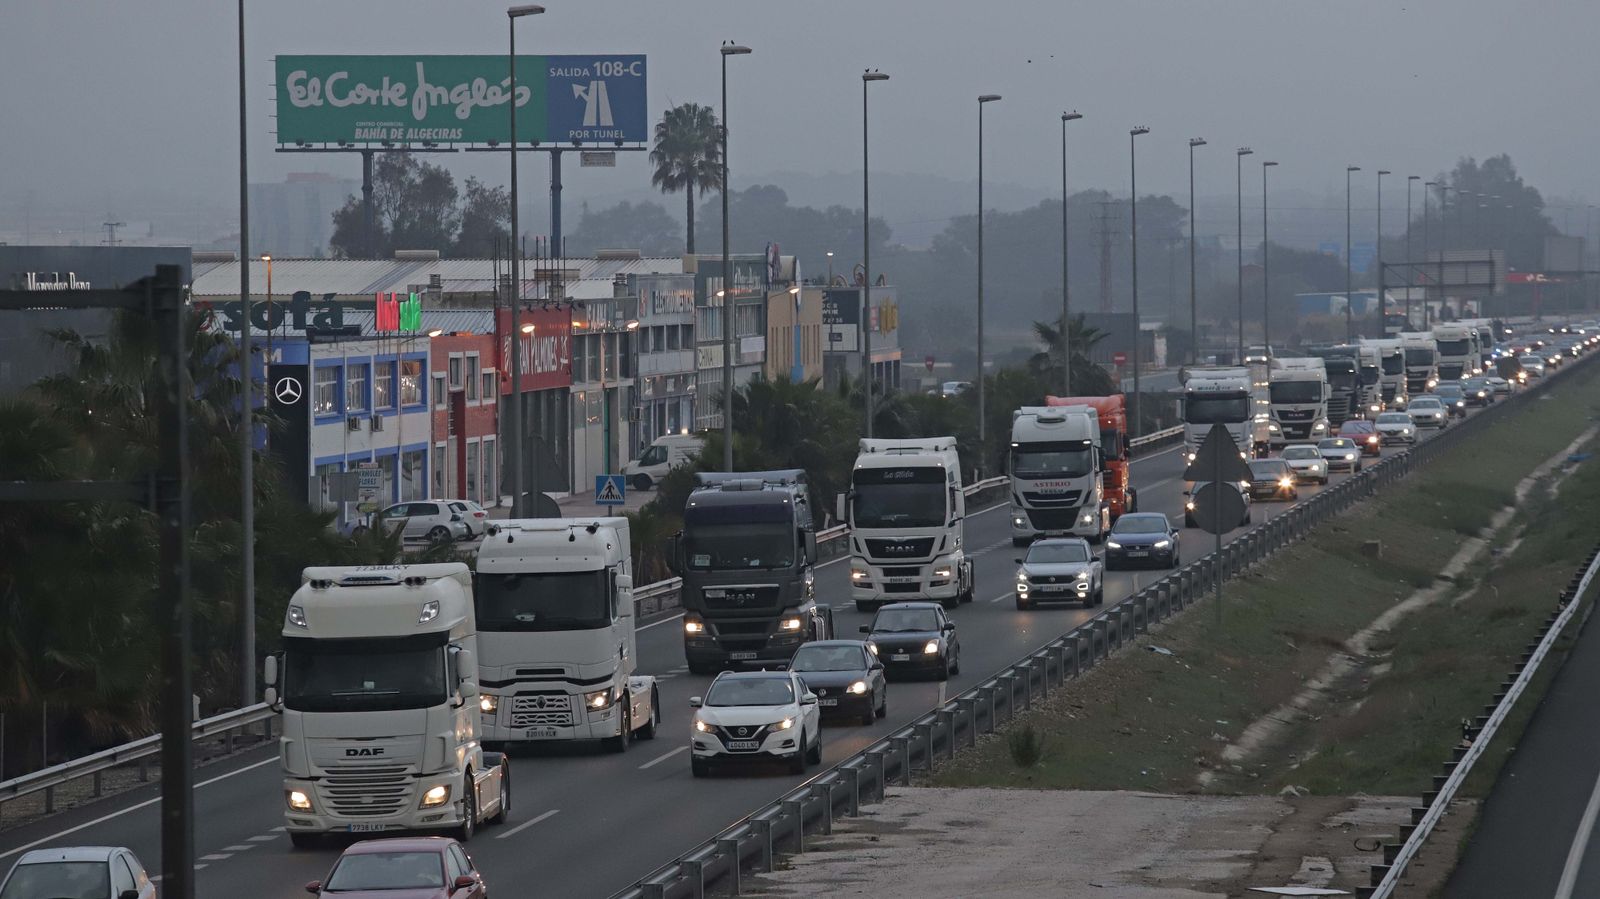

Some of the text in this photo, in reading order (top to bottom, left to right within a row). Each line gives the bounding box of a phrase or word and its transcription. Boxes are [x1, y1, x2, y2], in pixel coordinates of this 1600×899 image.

[550, 61, 642, 77] SALIDA 108-C
[286, 61, 532, 121] El Corte Inglés
[354, 127, 463, 139] BAHÍA DE ALGECIRAS
[569, 130, 625, 139] POR TUNEL
[223, 290, 343, 332] sofá
[698, 348, 713, 367] CHINA
[345, 748, 384, 756] DAF
[371, 824, 384, 832] LKY
